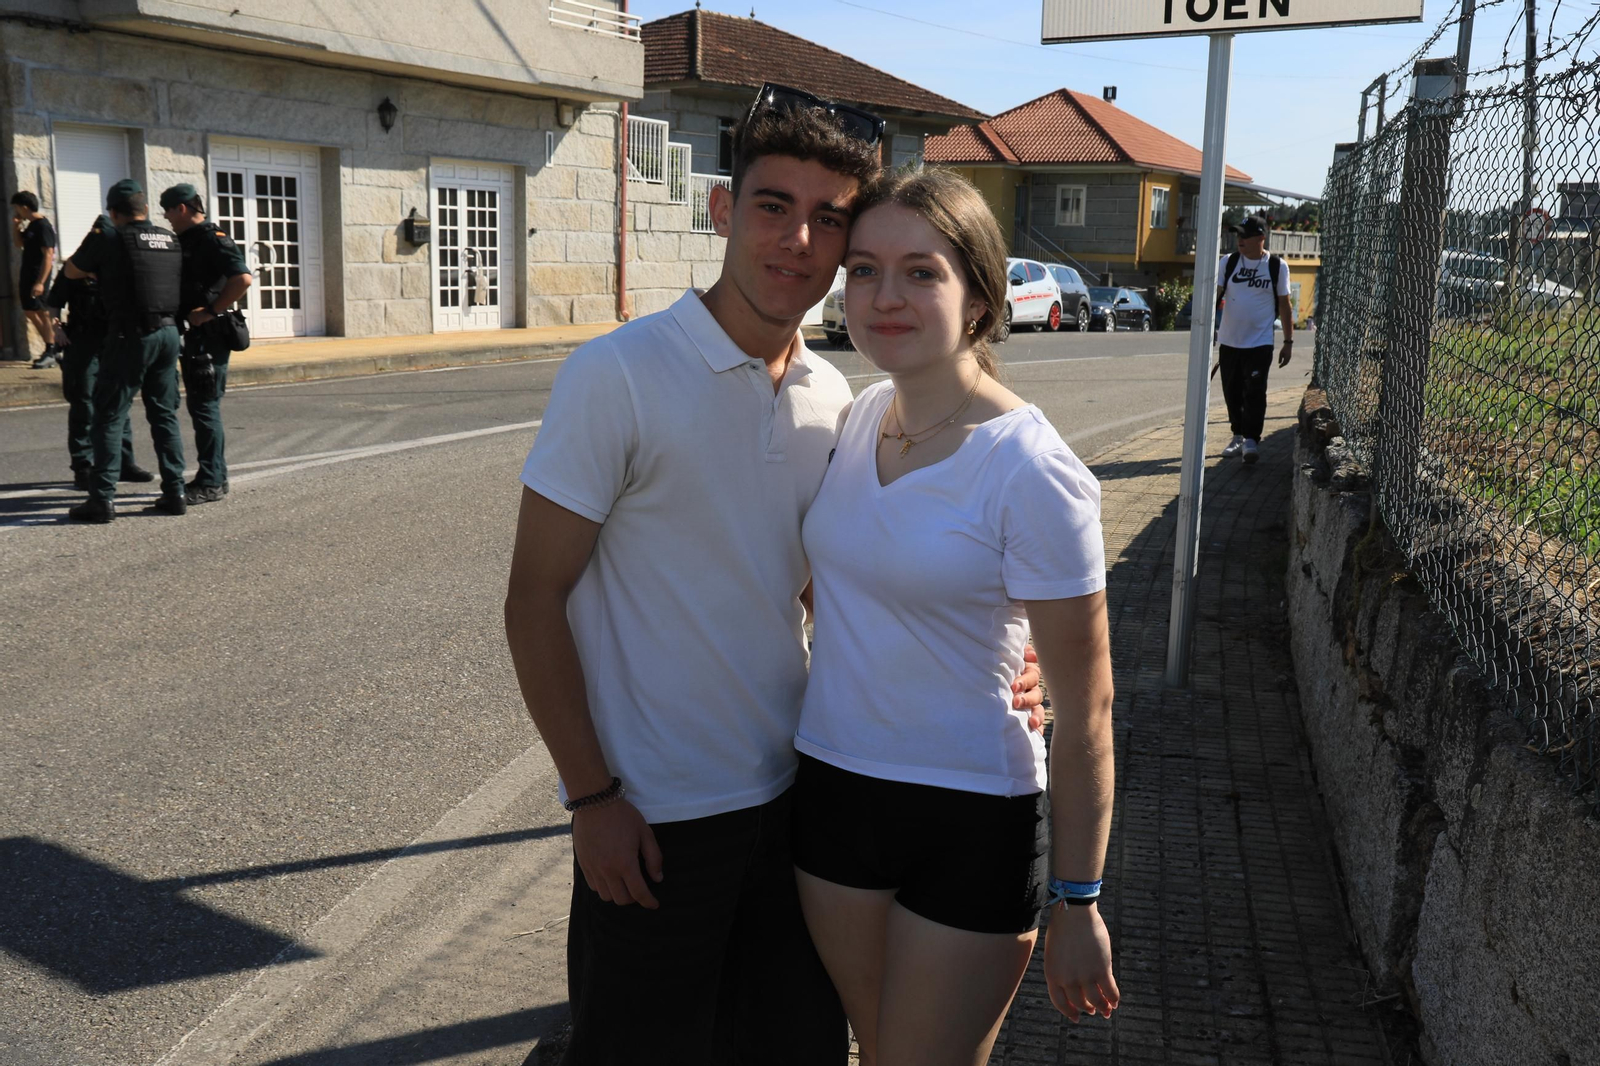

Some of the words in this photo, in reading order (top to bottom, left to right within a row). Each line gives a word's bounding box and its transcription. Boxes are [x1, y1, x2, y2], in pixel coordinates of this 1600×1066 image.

[140, 233, 173, 242] GUARDIA
[148, 241, 168, 249] CIVIL
[1238, 267, 1258, 277] JUST
